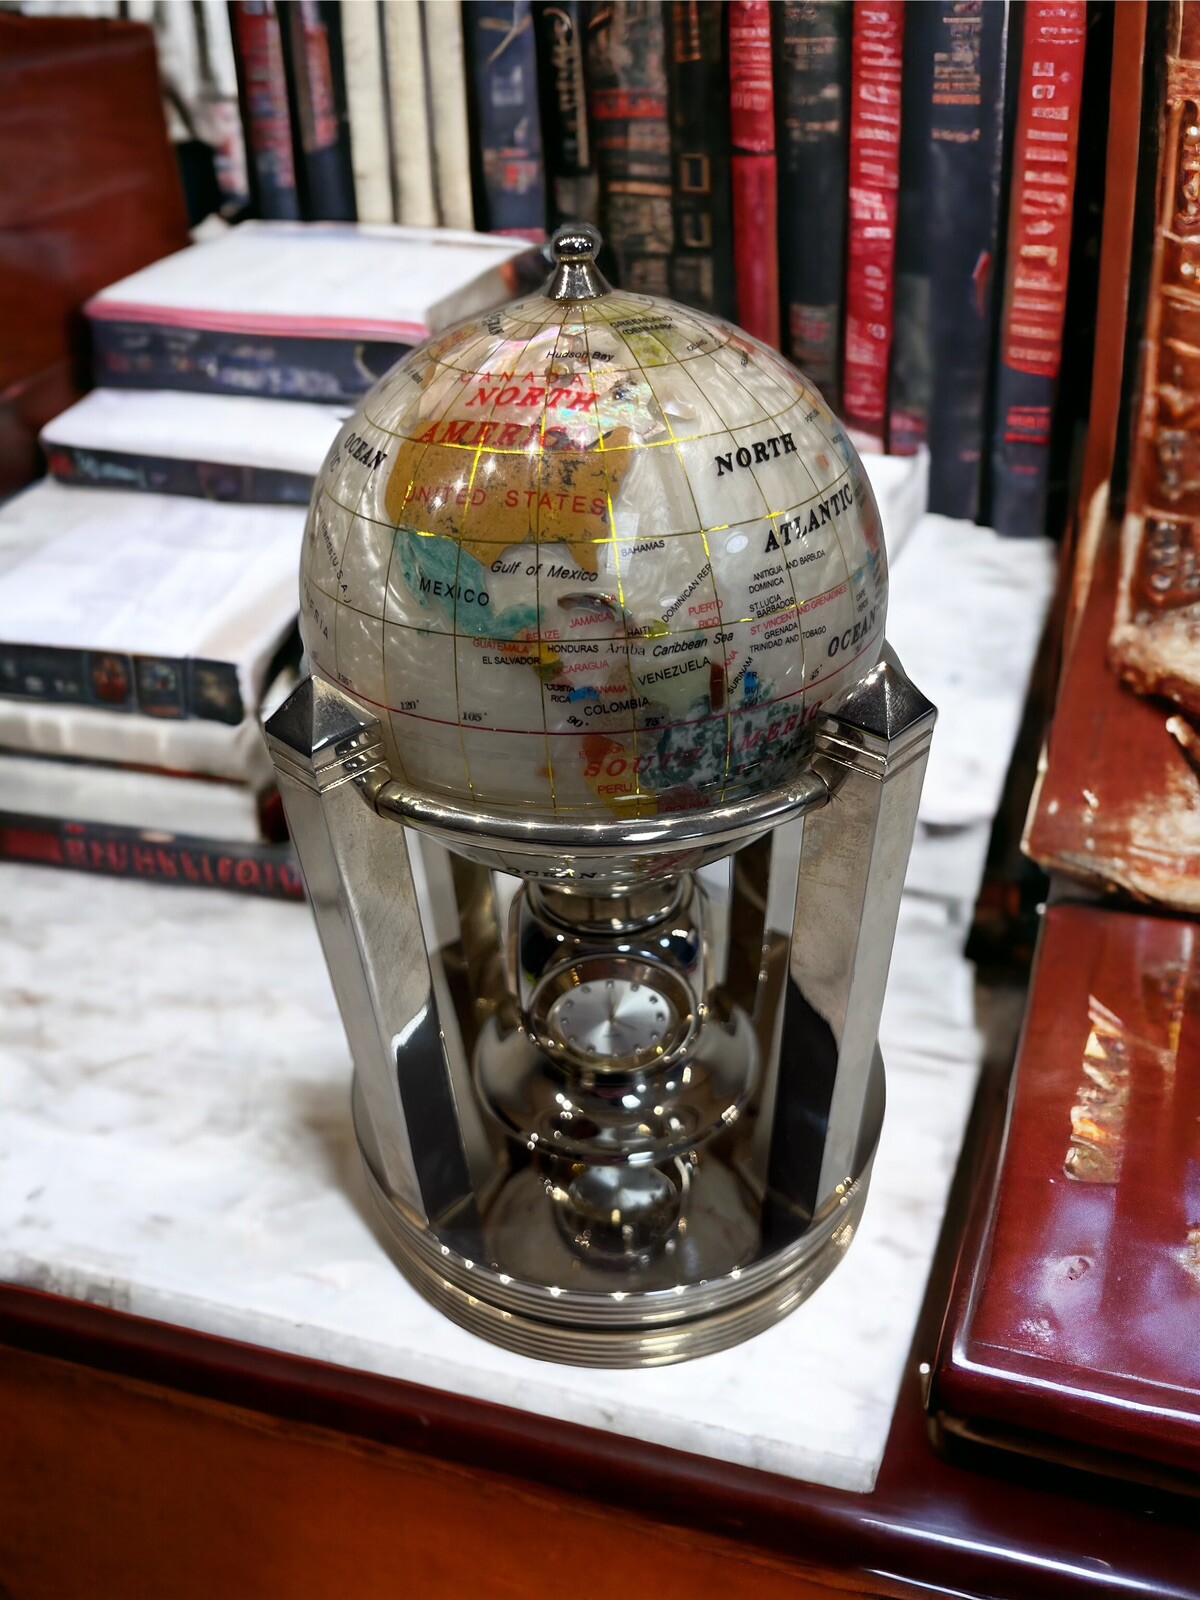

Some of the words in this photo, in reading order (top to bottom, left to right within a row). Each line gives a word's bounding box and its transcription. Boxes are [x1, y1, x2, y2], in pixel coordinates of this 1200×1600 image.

[546, 350, 589, 360] Hudson
[592, 351, 614, 362] Bay
[460, 371, 584, 387] CANADA
[465, 386, 600, 413] NORTH
[344, 432, 388, 470] OCEAN
[714, 432, 798, 477] NORTH
[505, 489, 606, 516] STATES
[763, 483, 854, 553] ATLANTIC
[621, 539, 665, 557] BAHAMAS
[785, 559, 799, 571] AND
[800, 549, 827, 566] BARBUDA
[491, 559, 521, 575] Gulf
[525, 562, 541, 578] of
[547, 564, 599, 582] Mexico
[418, 578, 490, 607] MEXICO
[748, 576, 785, 594] DOMINICA
[661, 580, 700, 624] DOMINICAN
[688, 600, 724, 617] PUERTO
[756, 596, 796, 619] BARBADOS
[763, 609, 797, 631] VINCENT
[796, 605, 811, 617] AND
[811, 584, 849, 609] GRENADINES
[569, 612, 612, 629] JAMAICA
[698, 616, 721, 628] RICO
[525, 629, 560, 641] BELIZE
[627, 625, 651, 638] HAITI
[749, 638, 783, 654] TRINIDAD
[785, 634, 800, 645] AND
[802, 625, 827, 639] TOBAGO
[764, 622, 799, 640] GRENADA
[827, 605, 877, 658] OCEAN
[472, 638, 530, 655] GUATEMALA
[547, 644, 599, 654] HONDURAS
[605, 643, 646, 656] Aruba
[652, 638, 708, 658] Caribbean
[713, 631, 734, 645] Sea
[482, 656, 493, 665] EL
[494, 656, 541, 665] SALVADOR
[552, 660, 610, 676] NICARAGUA
[637, 656, 712, 687] VENEZUELA
[727, 656, 754, 695] SURINAM
[550, 694, 572, 704] RICA
[584, 696, 651, 717] COLOMBIA
[597, 783, 633, 795] PERU
